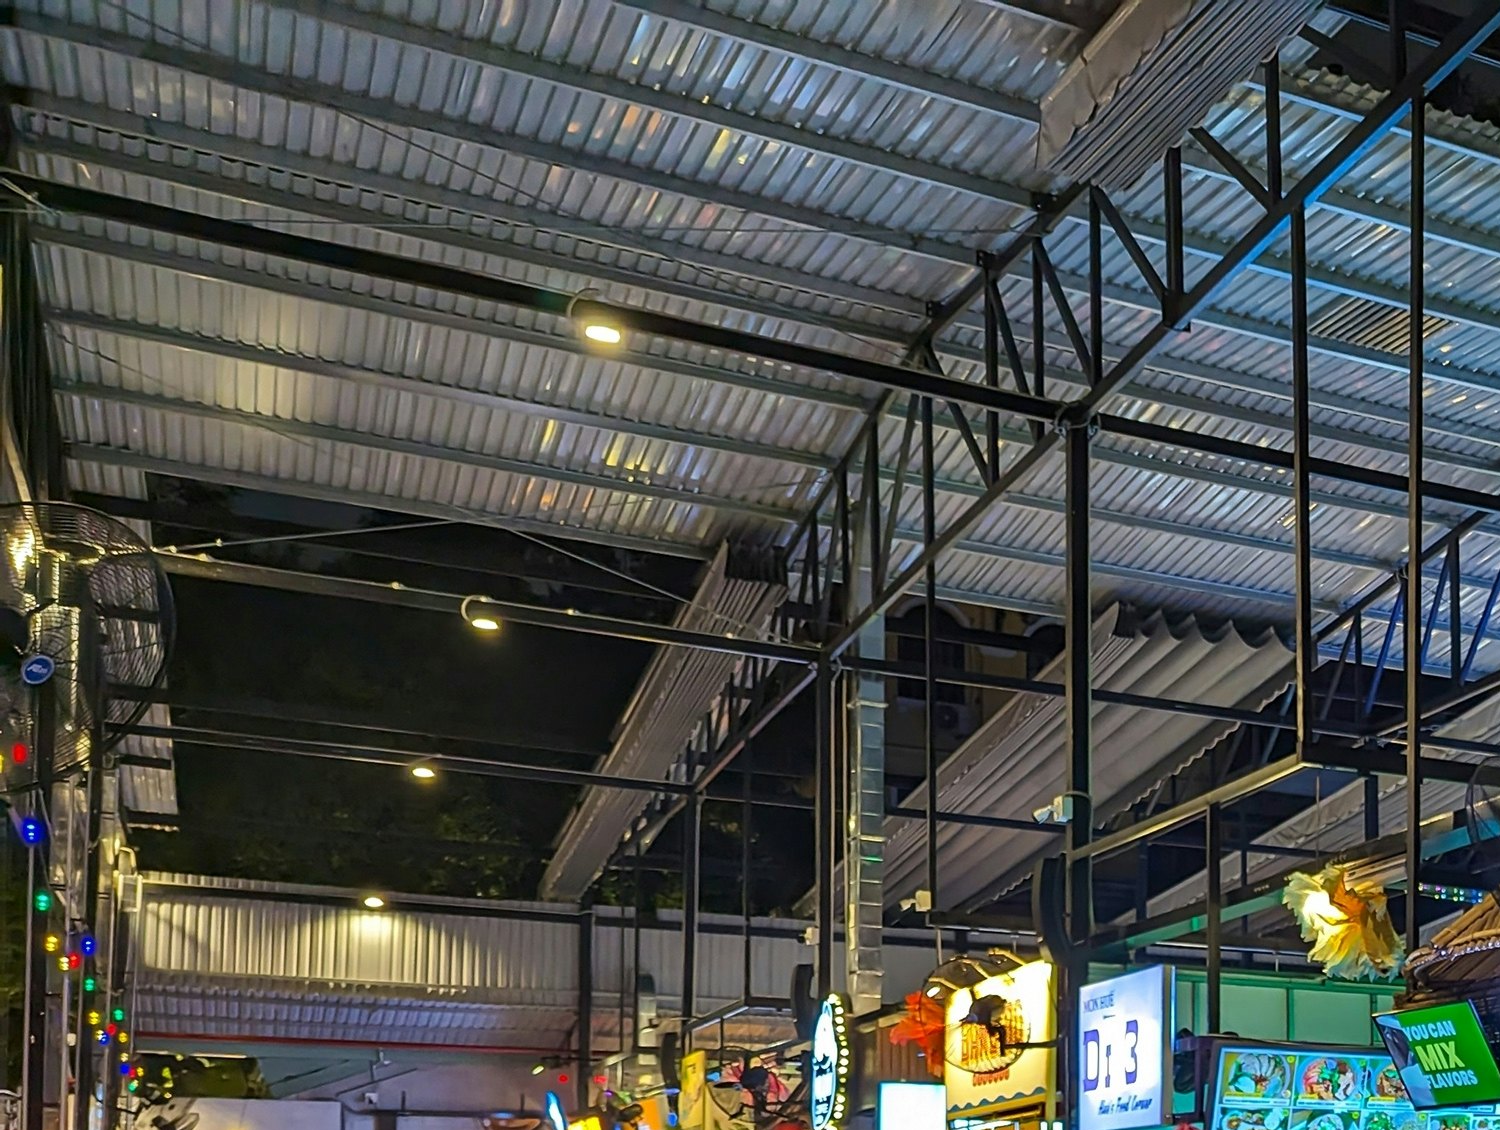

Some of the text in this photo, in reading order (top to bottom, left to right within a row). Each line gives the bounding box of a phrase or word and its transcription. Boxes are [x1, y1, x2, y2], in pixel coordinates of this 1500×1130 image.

[1403, 1020, 1456, 1042] YOU CAN
[1124, 1020, 1139, 1085] 3
[1415, 1041, 1465, 1072] MIX
[1426, 1069, 1478, 1089] FLAVORS
